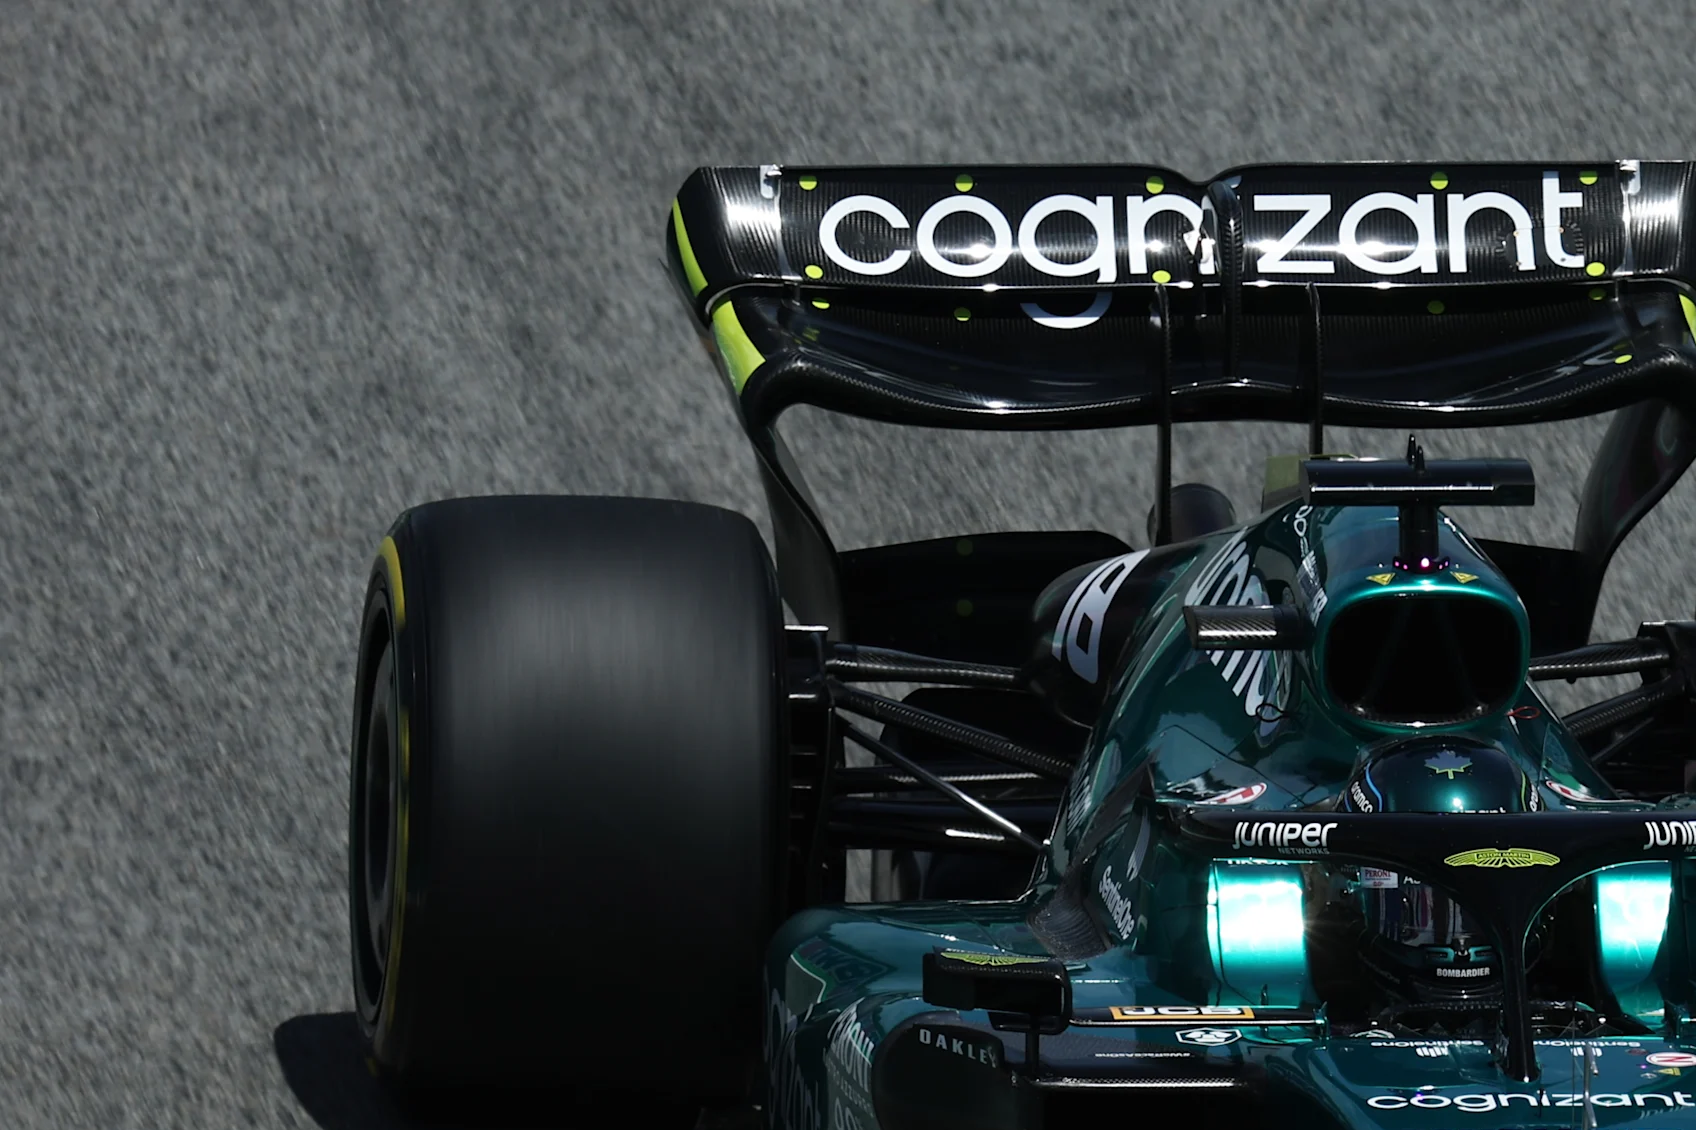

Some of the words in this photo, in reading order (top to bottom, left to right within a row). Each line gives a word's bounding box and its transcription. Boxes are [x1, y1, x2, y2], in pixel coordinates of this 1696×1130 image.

[818, 170, 1586, 329] cognzant
[1278, 847, 1331, 856] NETWORKS
[1436, 966, 1491, 978] BOMBARDIER
[918, 1028, 997, 1069] OAKLEY
[1367, 1090, 1696, 1113] cognizant
